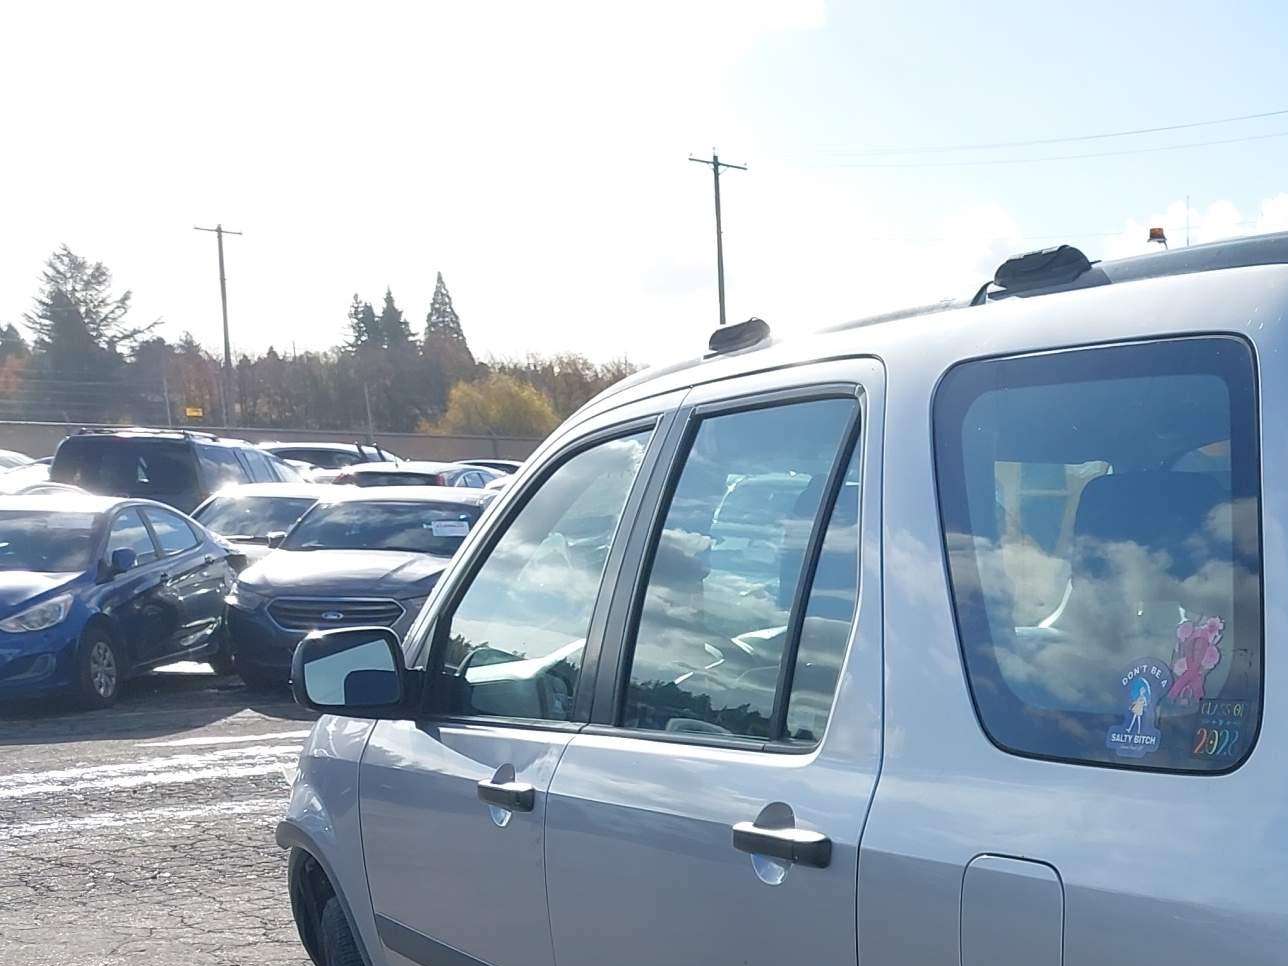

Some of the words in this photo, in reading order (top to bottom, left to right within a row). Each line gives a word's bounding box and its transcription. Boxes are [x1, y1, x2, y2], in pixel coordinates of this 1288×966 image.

[1121, 664, 1148, 687] DON'T
[1151, 665, 1162, 680] BE
[1161, 679, 1168, 688] A
[1111, 732, 1133, 744] SALTY
[1133, 735, 1157, 745] BITCH
